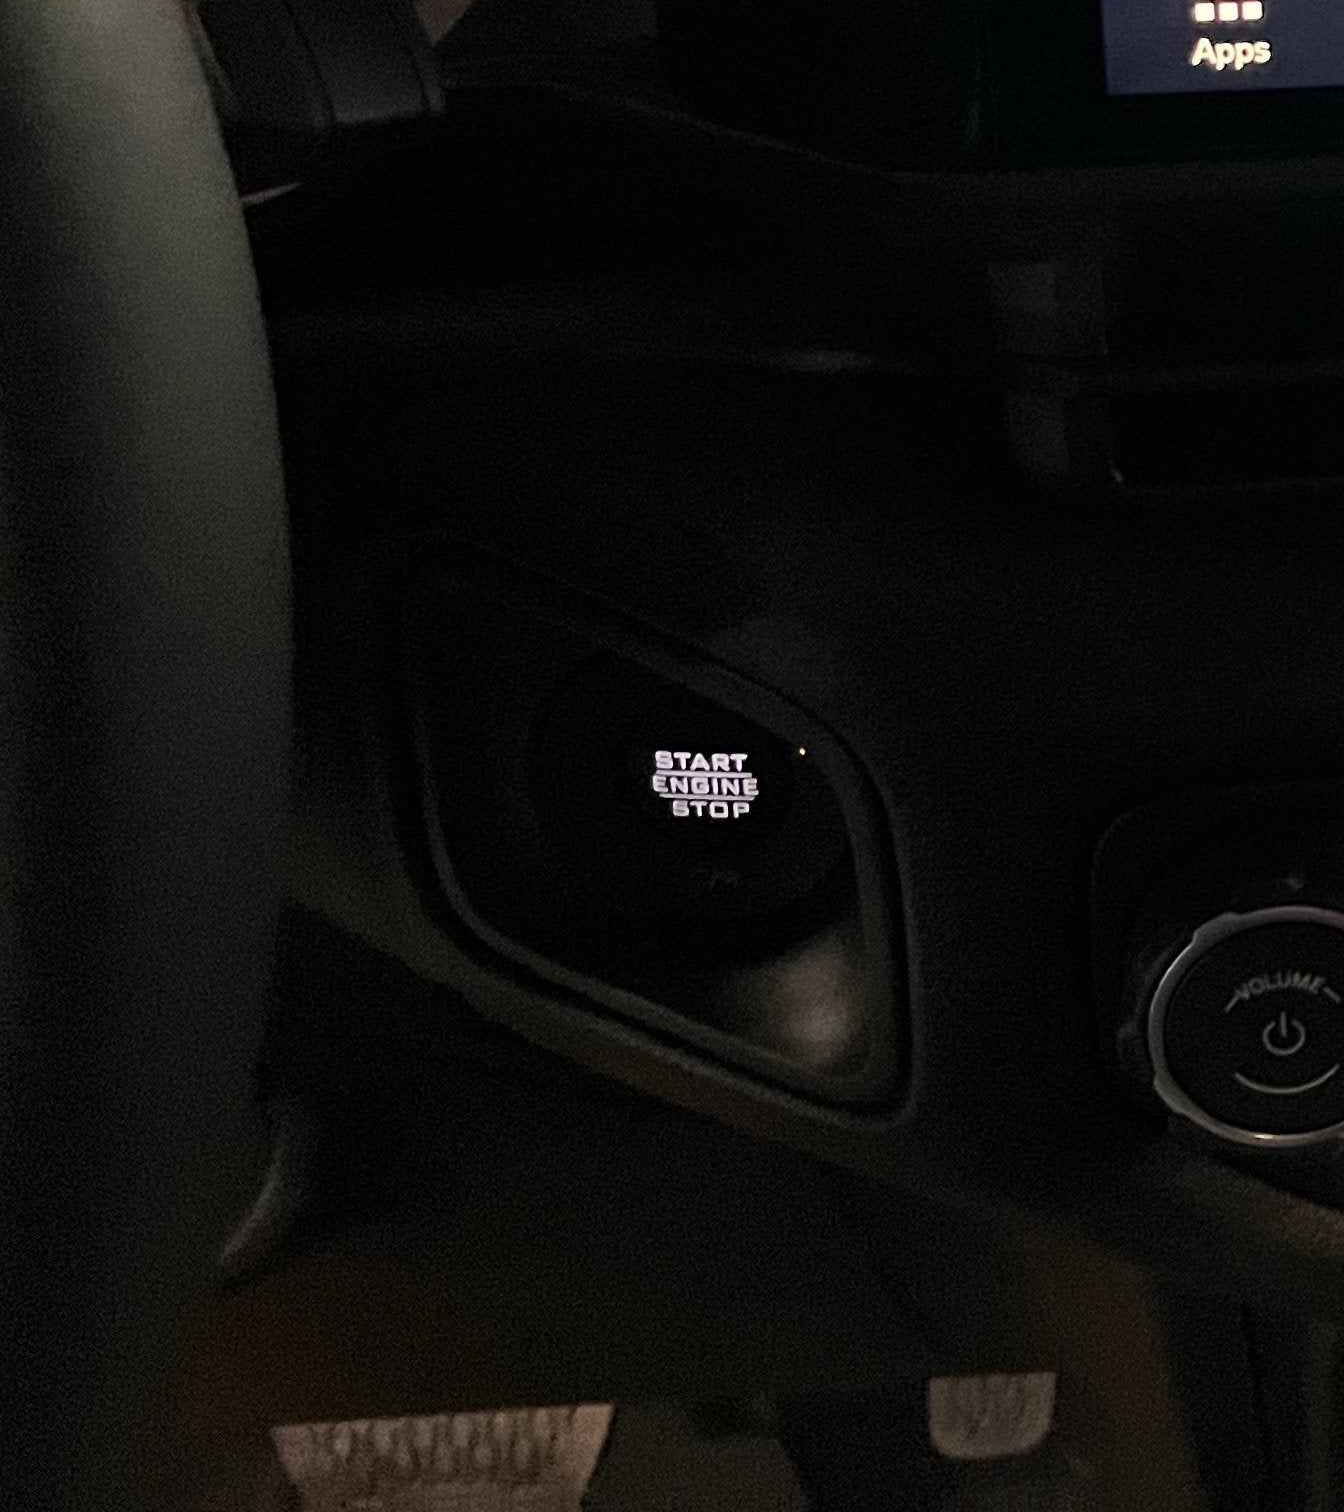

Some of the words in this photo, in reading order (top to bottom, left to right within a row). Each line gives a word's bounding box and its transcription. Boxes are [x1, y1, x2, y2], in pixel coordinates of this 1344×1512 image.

[1190, 38, 1271, 71] Apps
[655, 750, 748, 772] START
[653, 775, 759, 796] ENGINE
[672, 800, 750, 818] STOP
